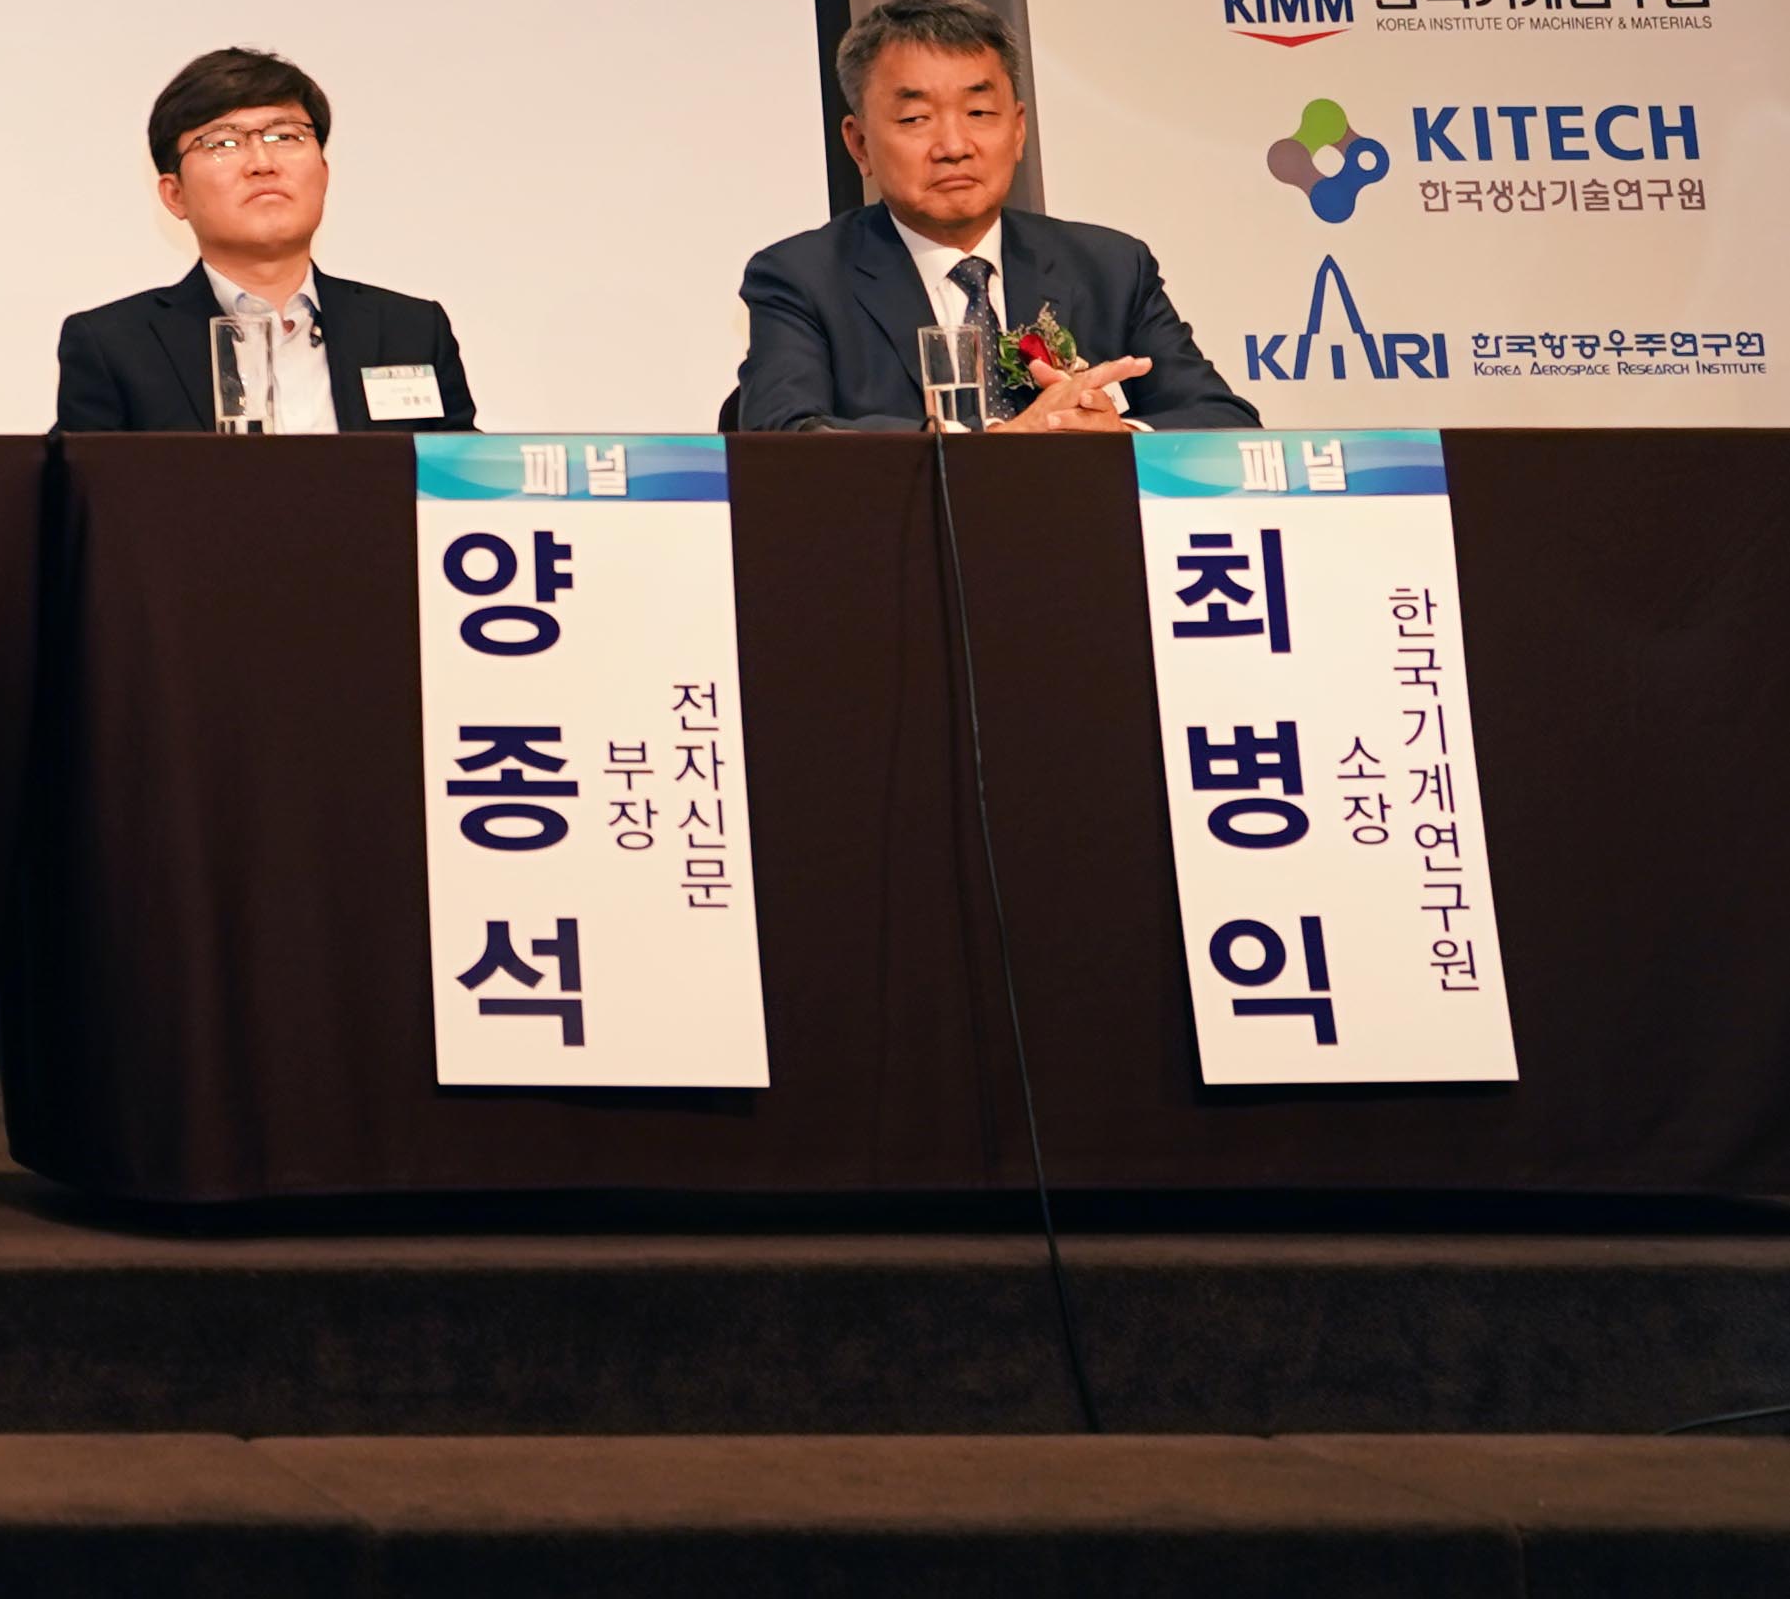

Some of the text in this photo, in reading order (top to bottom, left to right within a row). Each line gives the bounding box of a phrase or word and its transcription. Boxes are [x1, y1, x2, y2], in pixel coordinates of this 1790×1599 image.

[1376, 15, 1713, 31] KOREA INSTITUTE OF MACHINERY & MATERIALS
[1412, 105, 1700, 162] KITECH
[1418, 178, 1707, 214] 한국생산기술연구원
[1245, 254, 1449, 381] KARI
[1471, 329, 1766, 360] 한국항공우주연구원
[520, 443, 629, 498] 패널
[1237, 439, 1348, 494] 패널
[603, 740, 660, 851] 부장
[671, 681, 734, 909] 전자신문
[1337, 736, 1392, 847] 소장
[1388, 587, 1481, 993] 한국기계연구원
